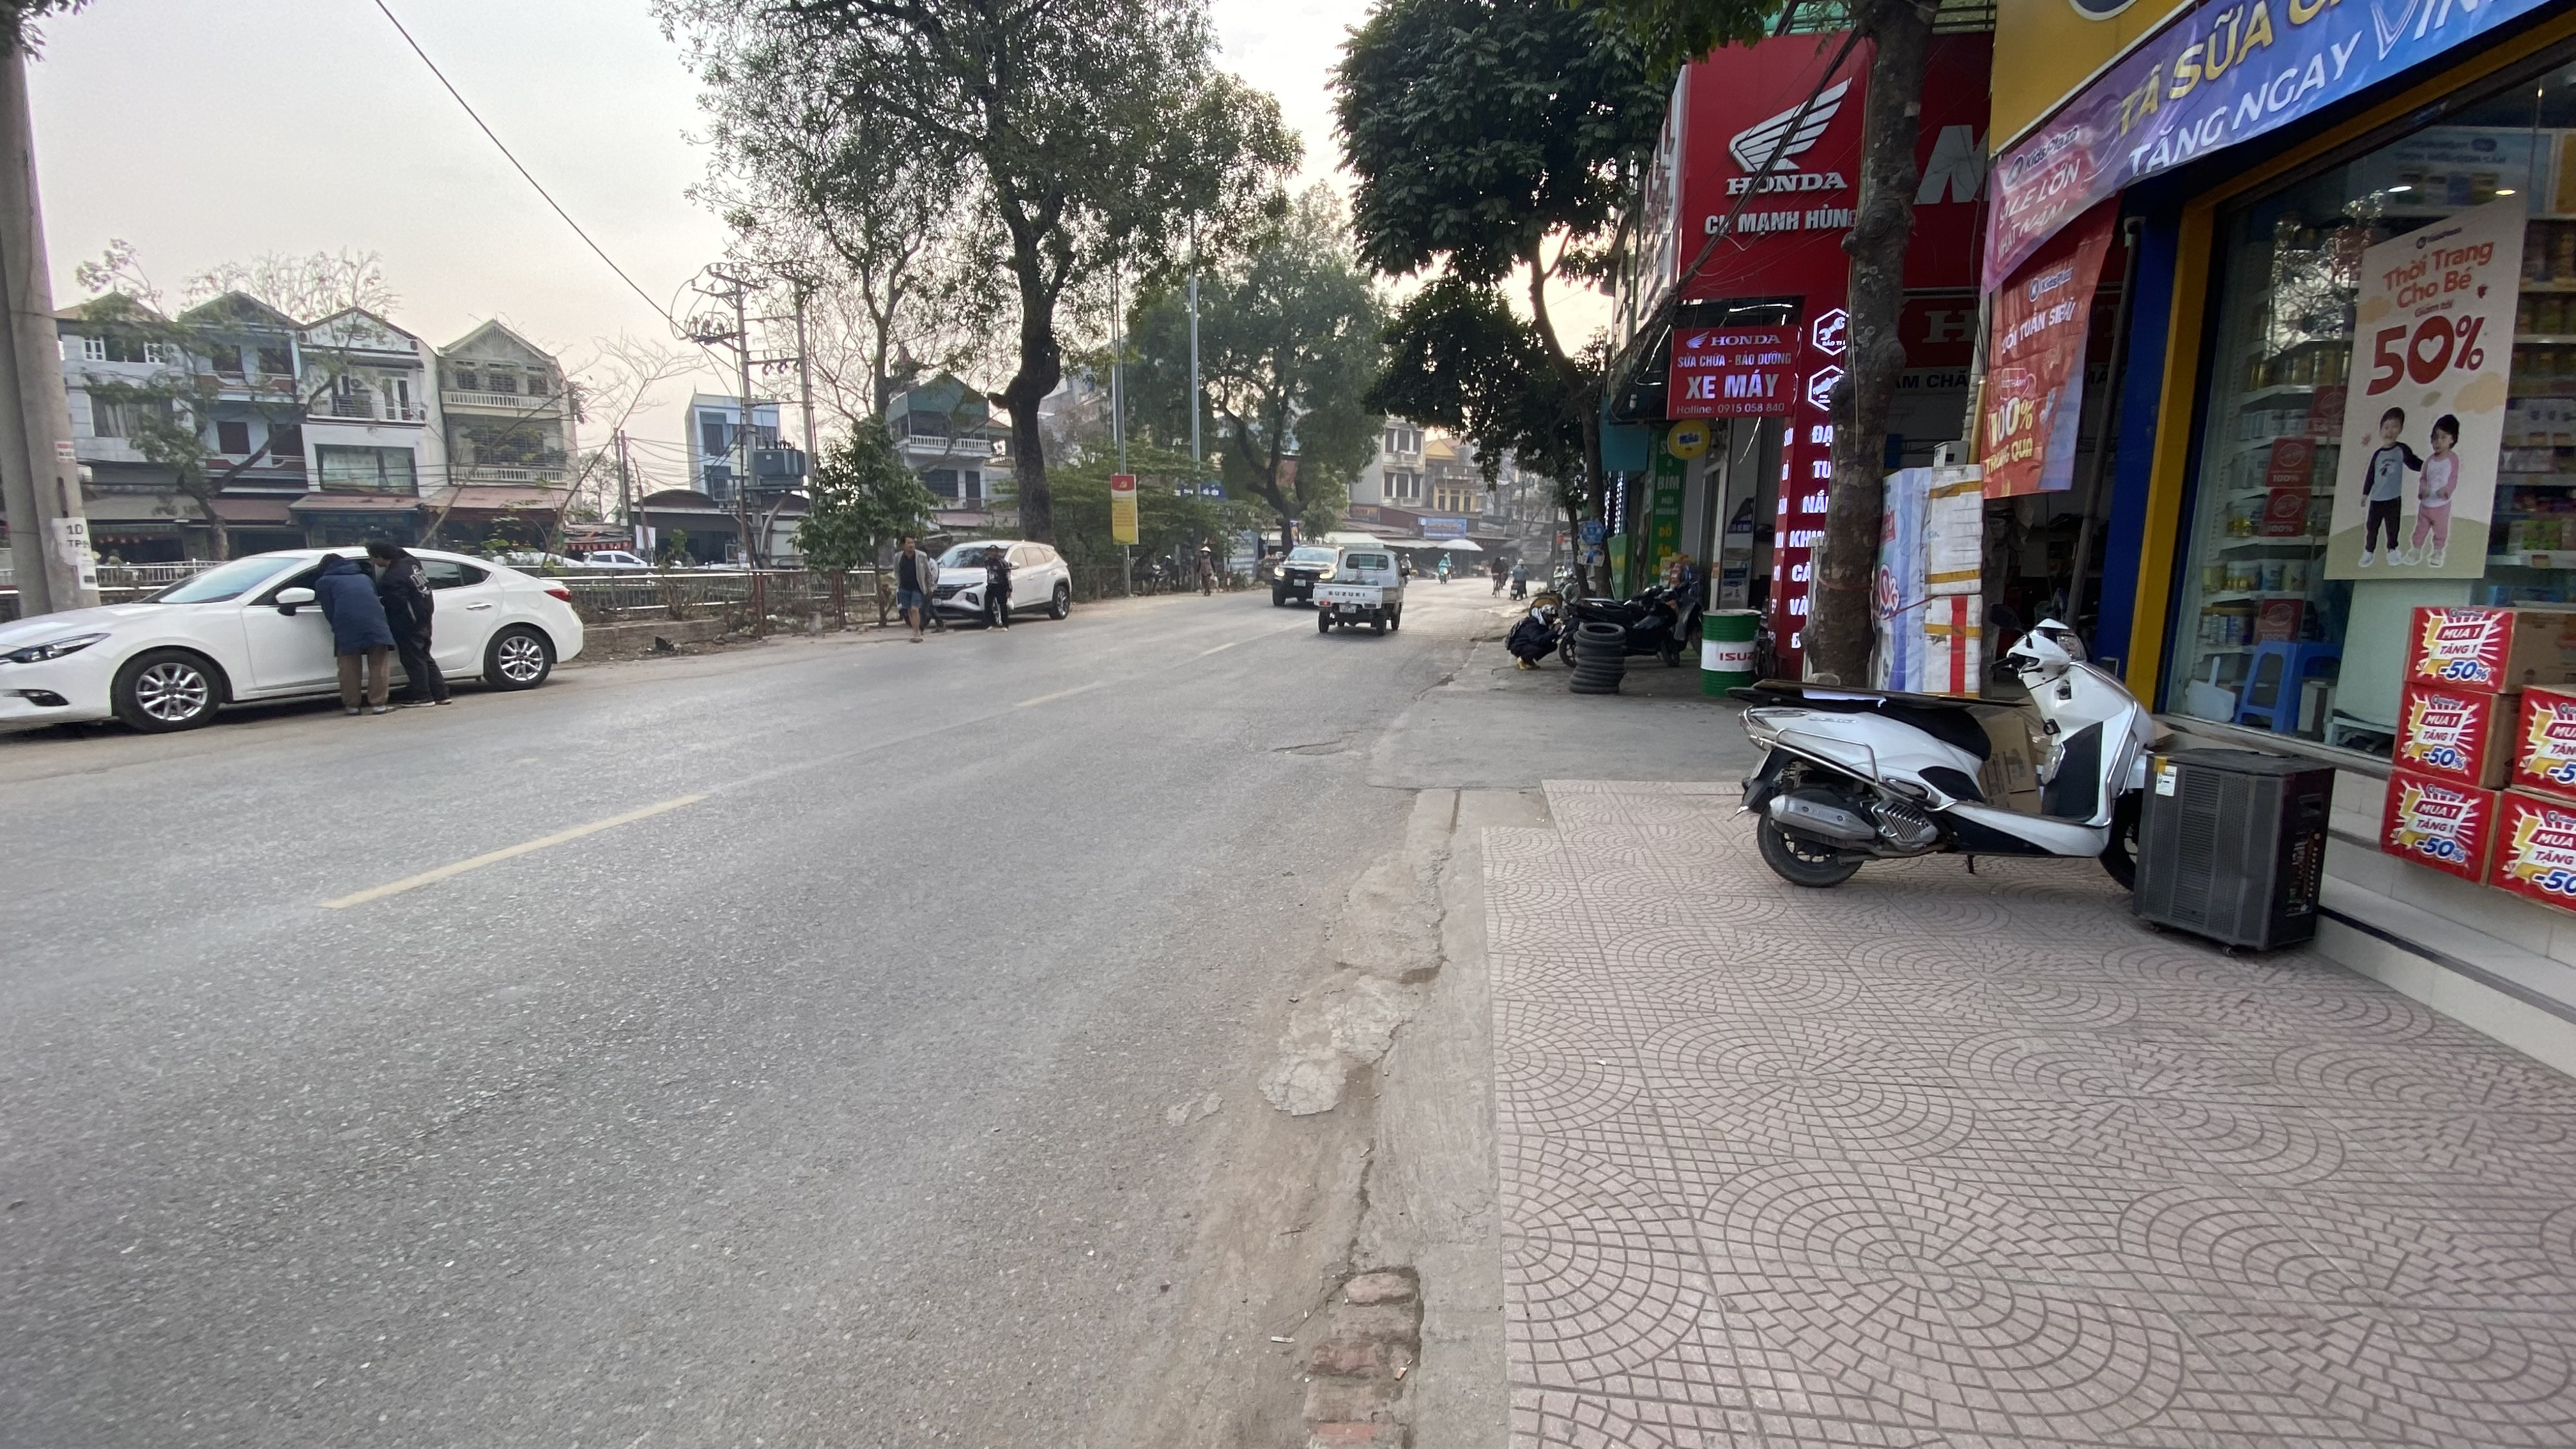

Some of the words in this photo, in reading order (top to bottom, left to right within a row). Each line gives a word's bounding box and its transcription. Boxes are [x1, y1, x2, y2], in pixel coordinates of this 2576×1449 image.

[2231, 30, 2363, 131] NGAY
[1726, 172, 1848, 195] HONDA
[1737, 211, 1799, 236] MẠNH
[2432, 241, 2495, 271] Trang
[2396, 282, 2439, 309] Cho
[2443, 266, 2472, 293] Bé
[1710, 335, 1782, 347] HONDA
[1677, 352, 1697, 368] SỬA
[1699, 352, 1726, 367] CHỮA
[1735, 351, 1755, 366] BẢO
[1758, 350, 1792, 365] DƯỠNG
[2366, 315, 2485, 396] 50%
[1685, 375, 1717, 399] XE
[1724, 369, 1779, 399] MÁY
[1927, 370, 1968, 388] CHĂ
[1717, 404, 1742, 413] 0915
[1744, 404, 1763, 413] 058
[1766, 403, 1785, 412] 840
[1989, 397, 2035, 447] 100%
[2442, 627, 2471, 639] MUA
[2472, 627, 2481, 638] 1
[1719, 652, 1757, 661] ISUZ
[2471, 644, 2478, 654] 1
[2440, 661, 2489, 680] -50%
[2425, 715, 2450, 726] MUA
[2450, 716, 2458, 726] 1
[2450, 733, 2457, 742] 1
[2549, 763, 2576, 782] -5
[2419, 804, 2448, 817] MUA
[2449, 808, 2458, 818] 1
[2448, 824, 2455, 833] 1
[2416, 837, 2465, 861] -50%
[2536, 833, 2574, 848] MUA
[2534, 850, 2575, 866] TẶNG
